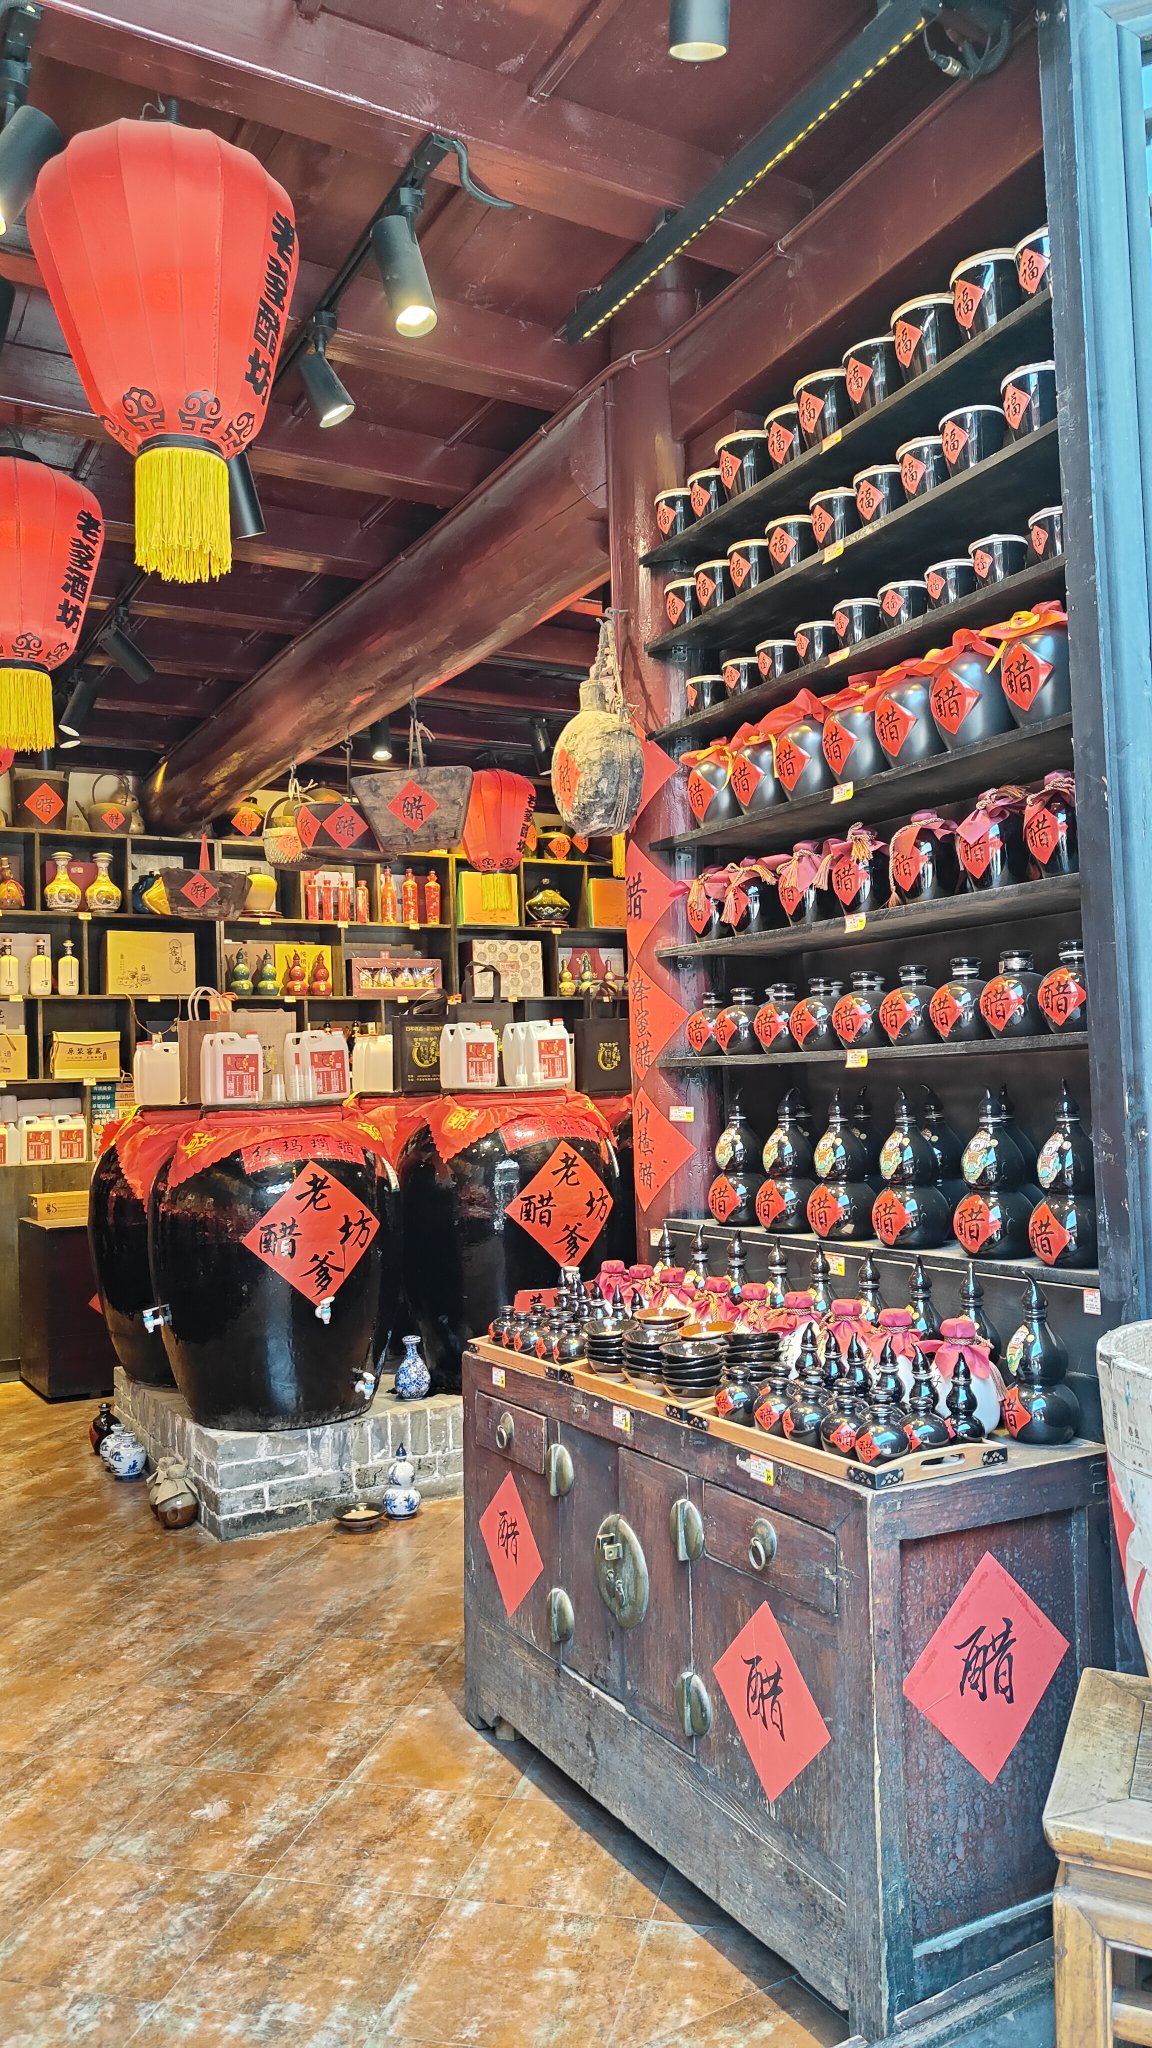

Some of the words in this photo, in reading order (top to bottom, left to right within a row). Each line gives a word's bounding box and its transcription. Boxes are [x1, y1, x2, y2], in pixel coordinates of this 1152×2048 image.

[1022, 255, 1039, 285] 福
[957, 288, 974, 317] 福
[897, 328, 911, 358] 福
[848, 365, 863, 394] 福
[800, 397, 816, 423] 福
[1007, 392, 1021, 419] 福
[770, 429, 784, 454] 福
[944, 429, 959, 453] 福
[721, 457, 733, 480] 福
[903, 462, 918, 486] 福
[692, 489, 704, 510] 福
[859, 488, 874, 512] 福
[658, 508, 669, 527] 福
[813, 511, 826, 534] 福
[772, 534, 788, 557] 福
[731, 559, 744, 580] 福
[697, 578, 709, 602] 福
[667, 598, 679, 620] 福
[1005, 654, 1034, 694] 醋
[934, 680, 962, 718] 醋
[877, 705, 900, 741] 醋
[824, 727, 842, 760] 醋
[776, 746, 796, 777] 醋
[732, 763, 750, 793] 醋
[689, 778, 704, 808] 醋
[239, 814, 254, 832] 醋
[402, 795, 426, 822] 醋
[336, 816, 356, 837] 醋
[1027, 816, 1051, 849] 醋
[836, 863, 855, 892] 醋
[930, 997, 951, 1026] 醋
[983, 987, 1010, 1019] 醋
[1042, 982, 1072, 1016] 醋
[631, 971, 654, 1069] 蜂蜜醋
[757, 1015, 775, 1038] 醋
[791, 1012, 807, 1037] 醋
[835, 1002, 858, 1033] 醋
[881, 1001, 903, 1029] 醋
[688, 1021, 703, 1044] 醋
[252, 1139, 353, 1162] 红玛瑙醋
[636, 1101, 656, 1189] 山楂醋
[712, 1186, 730, 1215] 醋
[757, 1190, 775, 1219] 醋
[810, 1195, 832, 1227] 醋
[875, 1199, 898, 1235] 醋
[958, 1204, 986, 1243] 醋
[1031, 1217, 1055, 1256] 醋
[497, 1509, 520, 1566] 醋
[954, 1617, 1016, 1705] 醋
[741, 1655, 786, 1743] 醋
